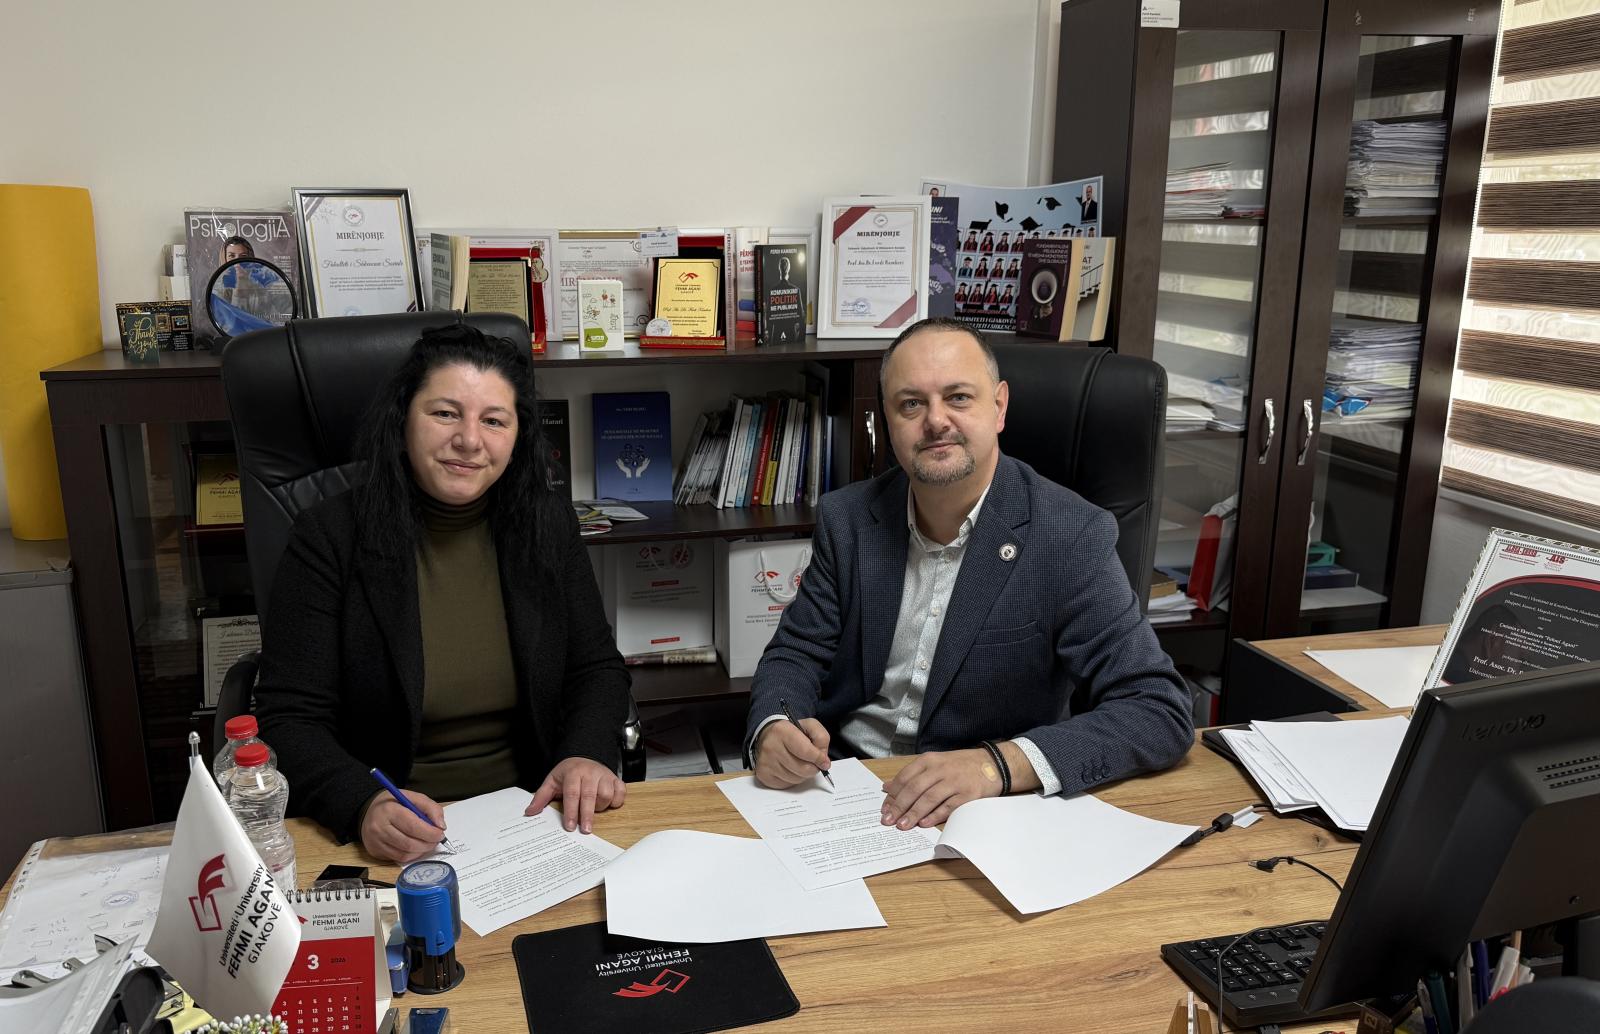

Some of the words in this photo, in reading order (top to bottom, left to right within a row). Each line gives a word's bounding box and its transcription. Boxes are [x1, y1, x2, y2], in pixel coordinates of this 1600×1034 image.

[771, 295, 798, 304] POLITIK
[1474, 656, 1488, 666] Prof.
[1489, 661, 1506, 672] Asoc.
[1507, 667, 1516, 675] Dr.
[248, 902, 282, 964] GJAKOVË
[228, 930, 253, 979] FEHMI
[617, 946, 664, 960] GJAKOVË
[646, 949, 690, 962] FEHMI
[307, 954, 320, 970] 3
[596, 957, 640, 971] AGANI
